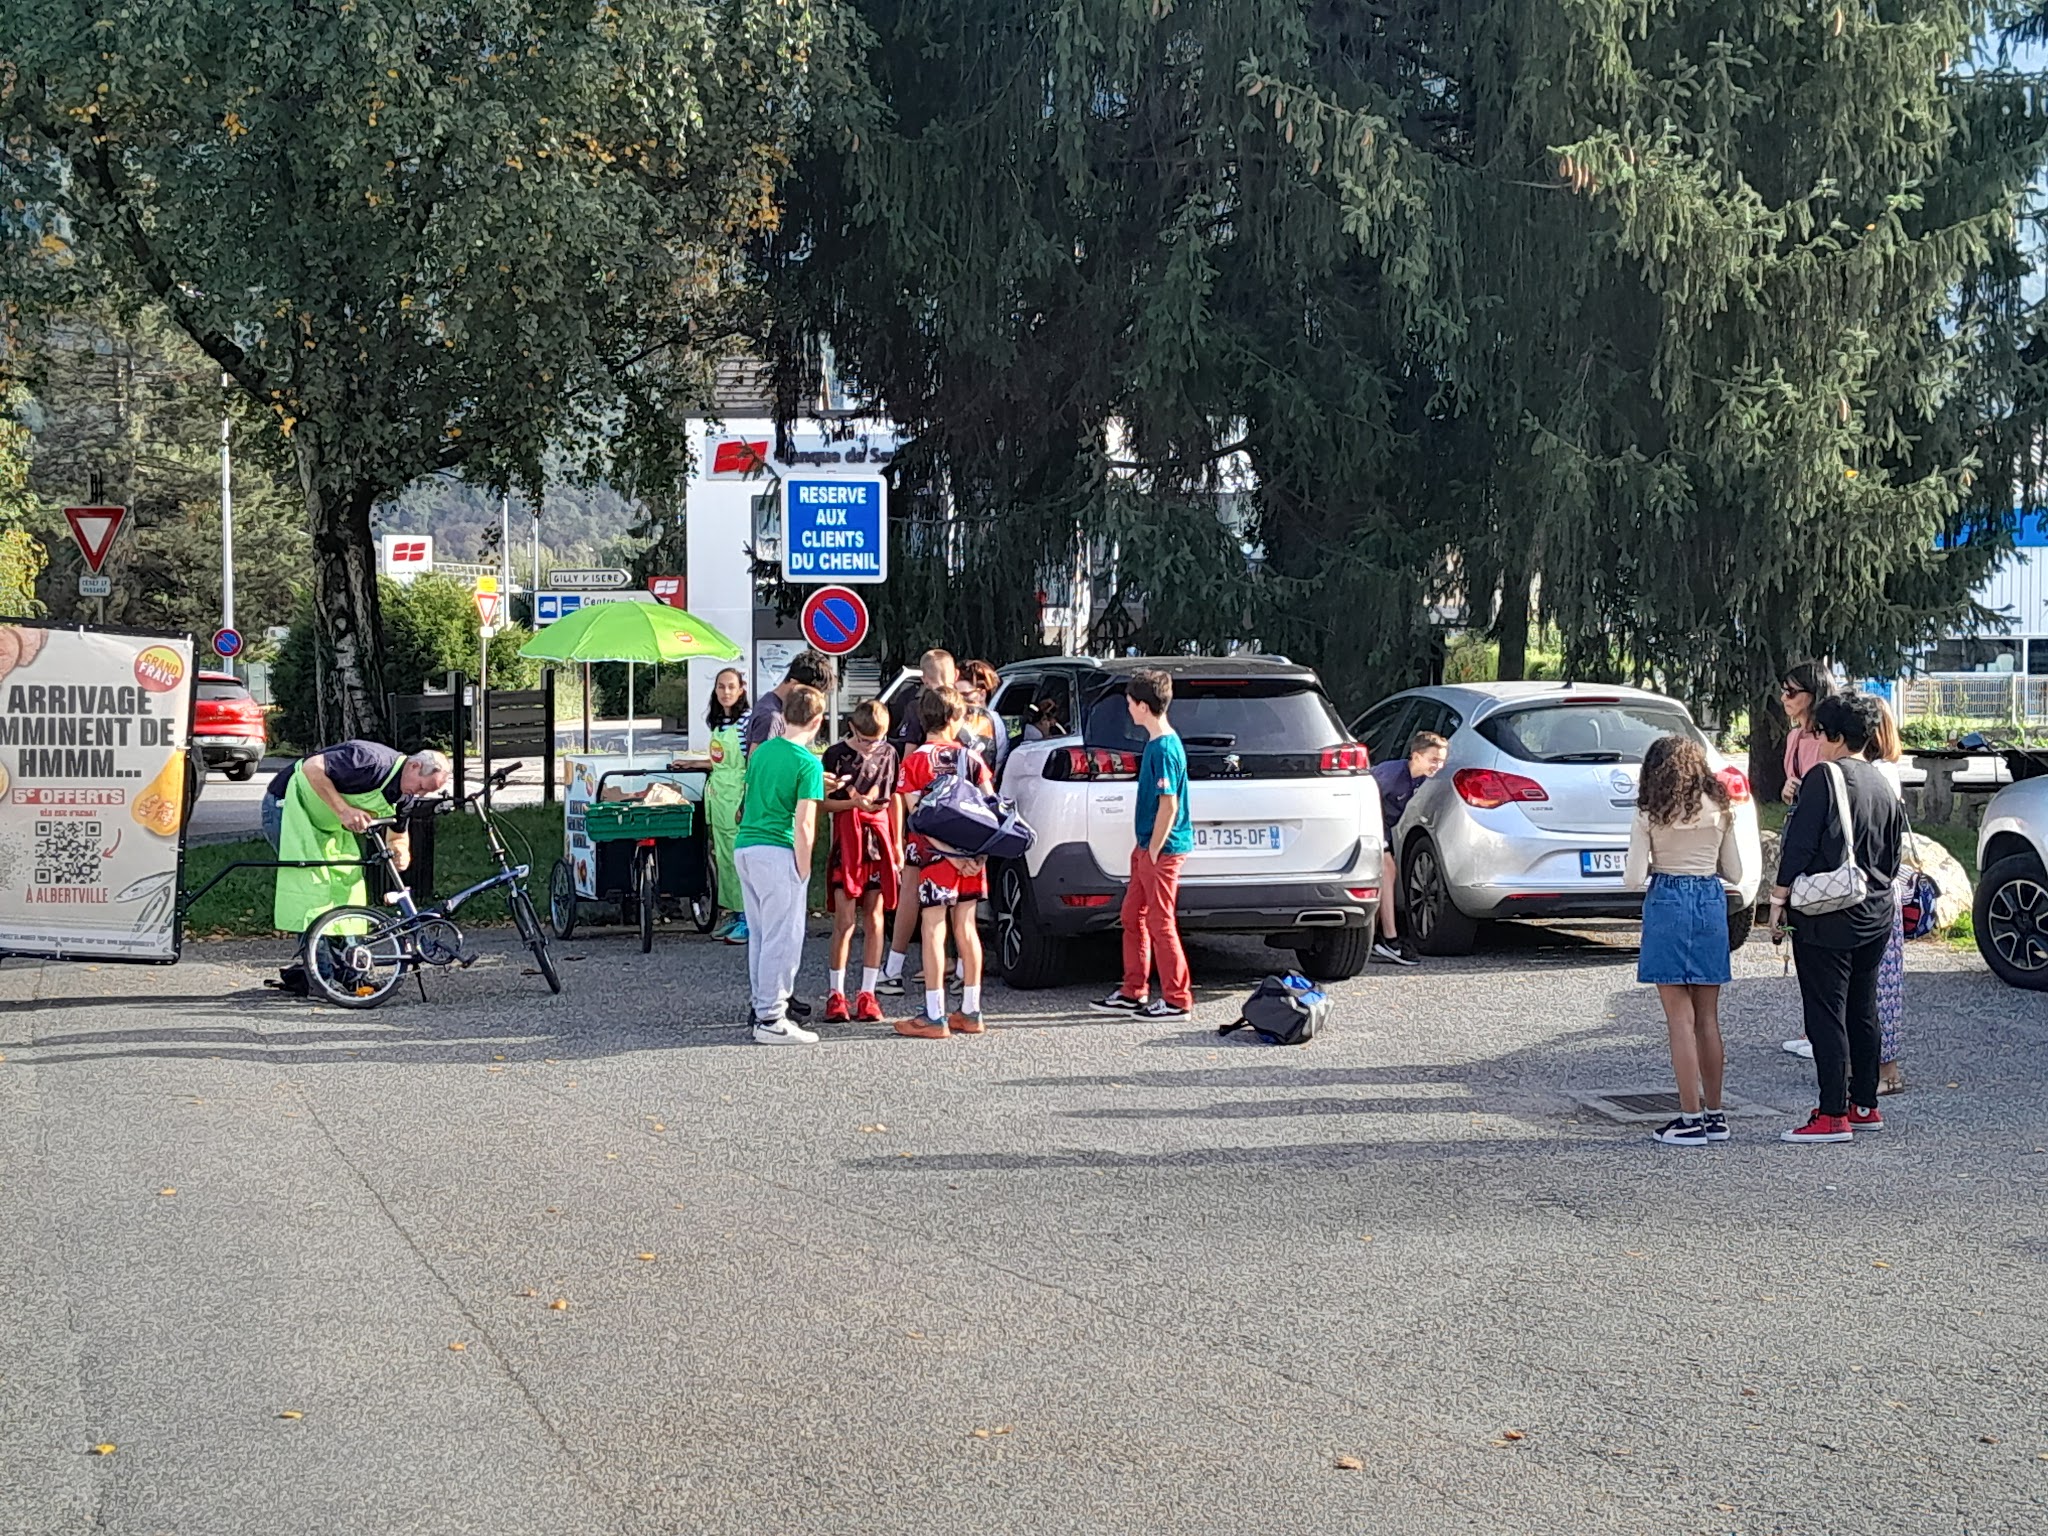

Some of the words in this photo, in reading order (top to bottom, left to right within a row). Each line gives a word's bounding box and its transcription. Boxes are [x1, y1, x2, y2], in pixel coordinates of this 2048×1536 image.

[799, 486, 867, 504] RESERVE
[815, 508, 847, 526] AUX
[801, 530, 864, 548] CLIENTS
[791, 552, 814, 570] DU
[819, 552, 879, 570] CHENIL
[553, 574, 578, 583] GILLY
[143, 653, 179, 675] GRAND
[138, 661, 175, 686] FRAIS
[7, 684, 153, 715] ARRIVAGE
[140, 718, 175, 747] DE
[18, 748, 142, 778] HMMM...
[39, 789, 124, 805] OFFERTS
[1193, 828, 1267, 846] Q-735-DF
[1593, 854, 1612, 869] VS
[26, 884, 33, 903] À
[36, 887, 109, 904] ALBERTVILLE
